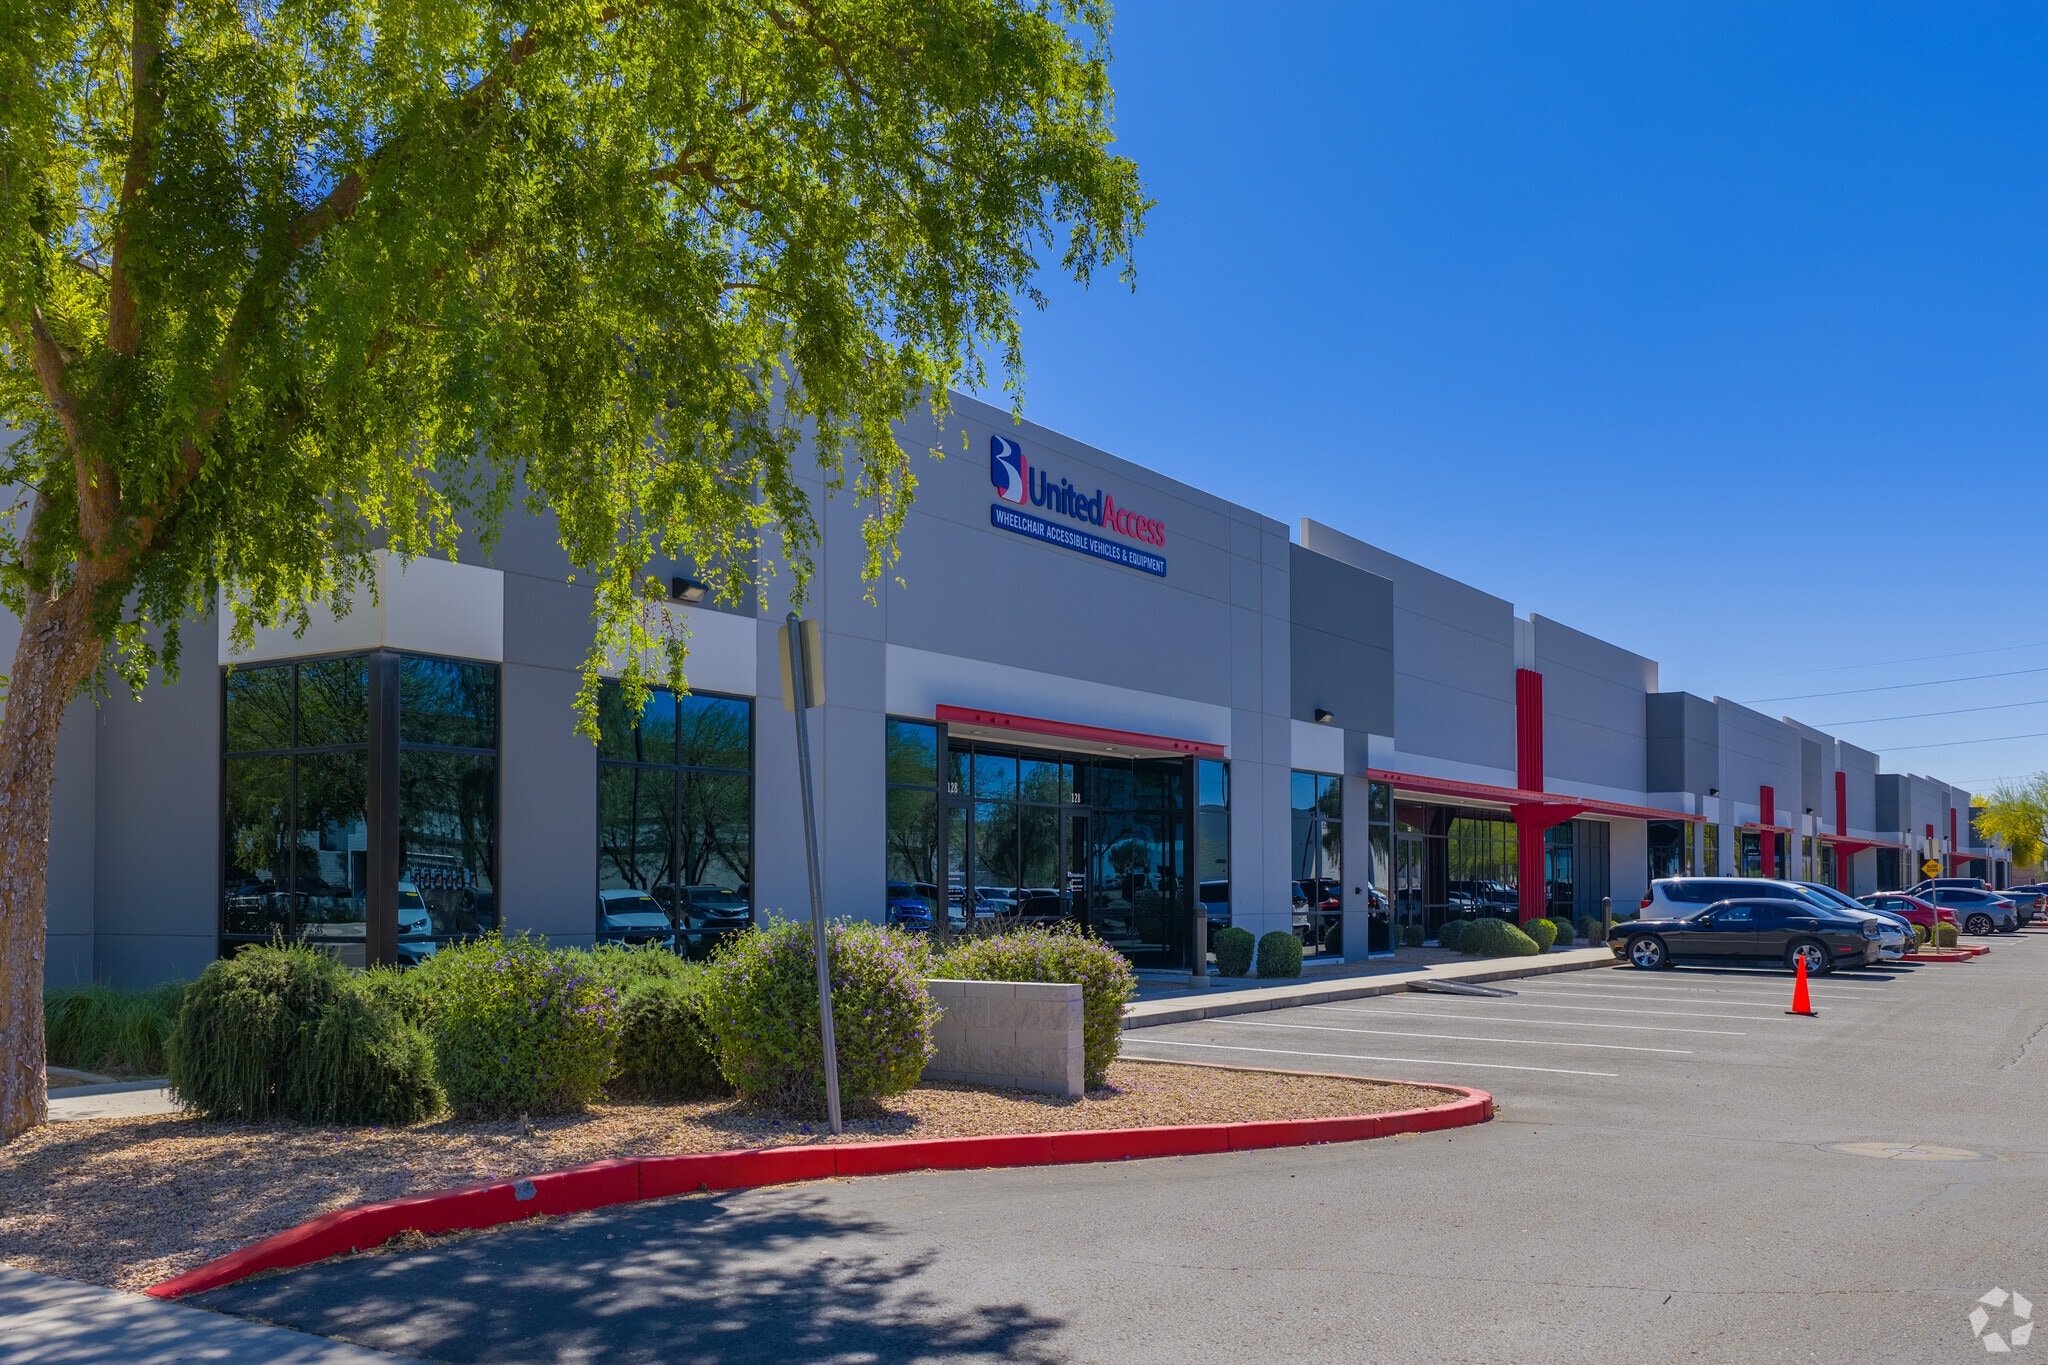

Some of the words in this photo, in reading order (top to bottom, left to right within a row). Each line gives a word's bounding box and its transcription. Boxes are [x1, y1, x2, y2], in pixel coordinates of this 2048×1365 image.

[995, 509, 1045, 537] WHEELCHAIR
[1046, 525, 1088, 550] ACCESSIBLE
[1089, 538, 1121, 560] VEHICLES
[1122, 549, 1128, 562] &
[1129, 551, 1164, 573] EQUIPMENT
[947, 782, 958, 794] 128
[1071, 793, 1081, 803] 128
